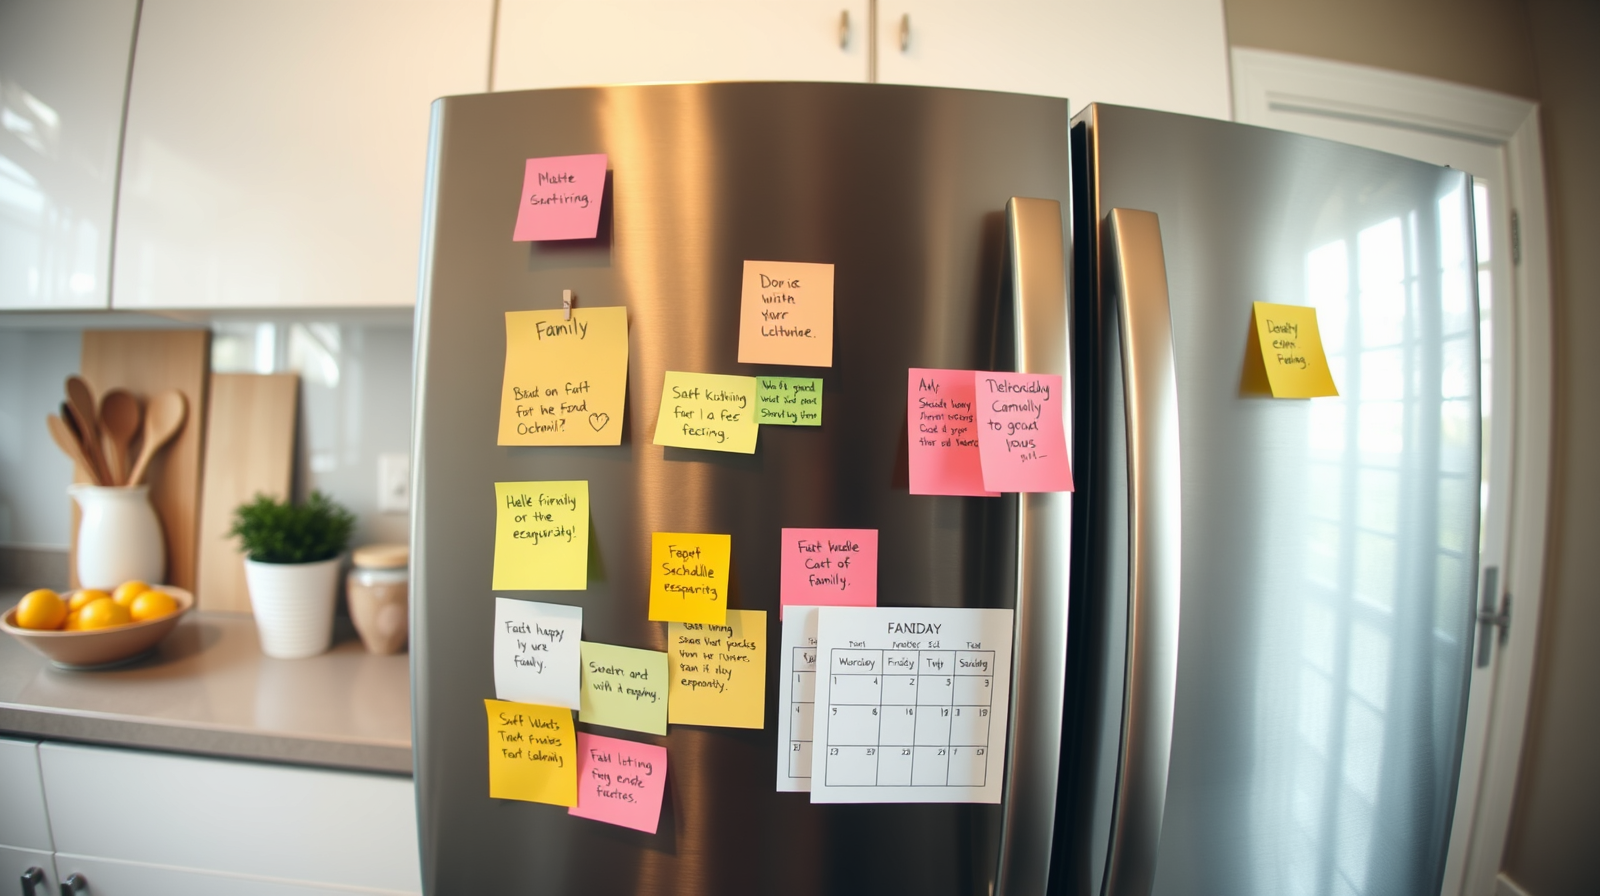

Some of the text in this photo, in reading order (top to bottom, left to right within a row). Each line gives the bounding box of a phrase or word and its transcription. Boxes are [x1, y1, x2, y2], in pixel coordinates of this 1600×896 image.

[535, 317, 588, 340] Family
[545, 387, 558, 397] on
[987, 419, 1002, 431] to
[837, 556, 851, 569] of
[887, 622, 942, 635] FANIDAY
[909, 678, 915, 686] 2
